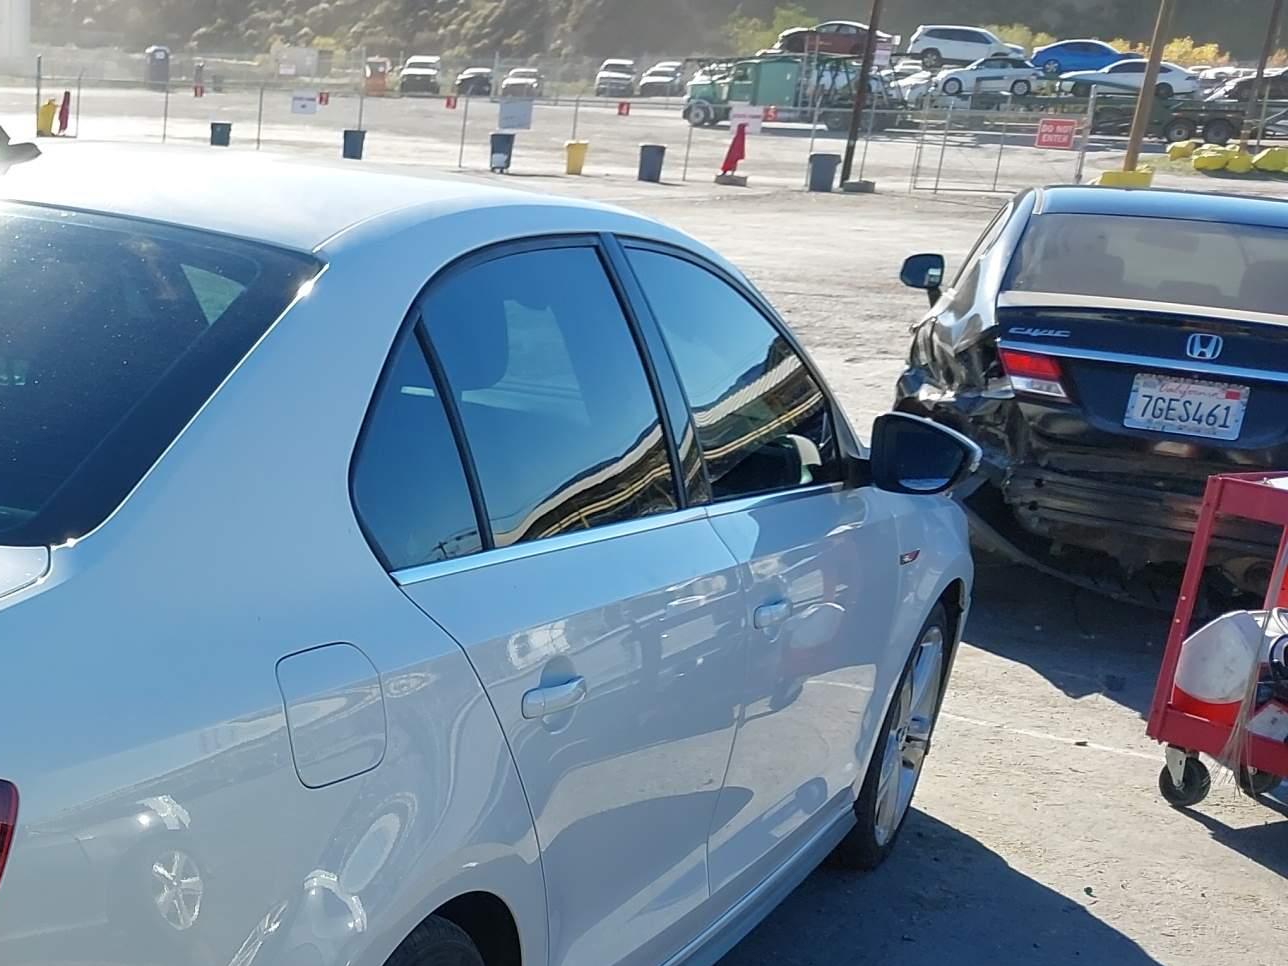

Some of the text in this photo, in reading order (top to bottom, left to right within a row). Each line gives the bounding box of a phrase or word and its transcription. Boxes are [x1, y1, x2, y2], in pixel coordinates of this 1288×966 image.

[1040, 123, 1072, 134] DO NOT
[1041, 133, 1069, 143] ENTER
[1140, 393, 1232, 430] 7GES461
